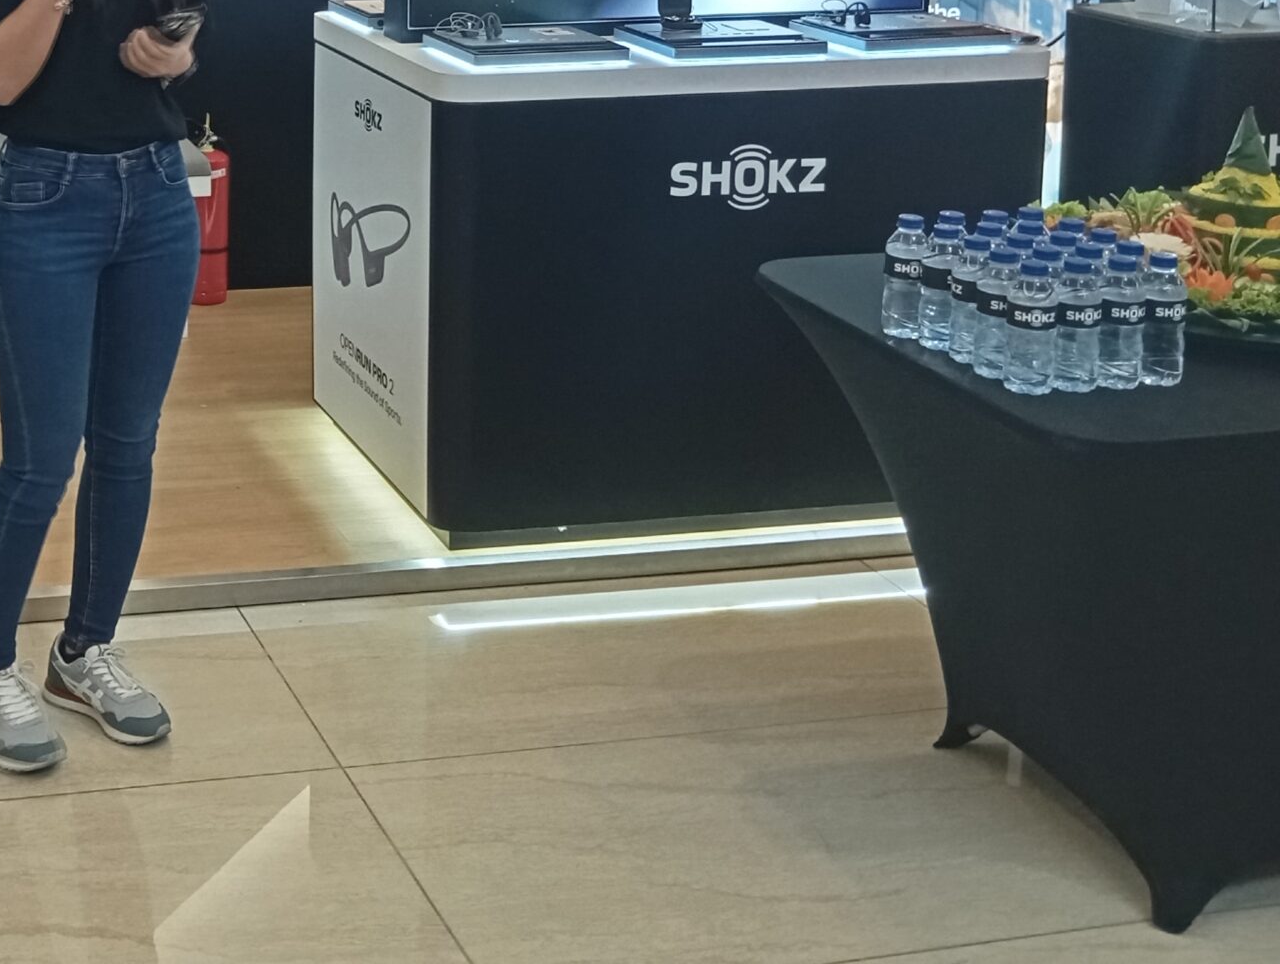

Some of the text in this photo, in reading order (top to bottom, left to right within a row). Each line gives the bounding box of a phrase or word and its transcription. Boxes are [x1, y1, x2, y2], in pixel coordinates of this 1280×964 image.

[354, 99, 382, 132] SHOKZ
[670, 157, 827, 198] SHOKZ
[1014, 310, 1056, 324] SHOKZ
[333, 350, 355, 384] Redefining
[356, 373, 364, 389] the
[340, 333, 394, 396] OPENRUN PRO 2
